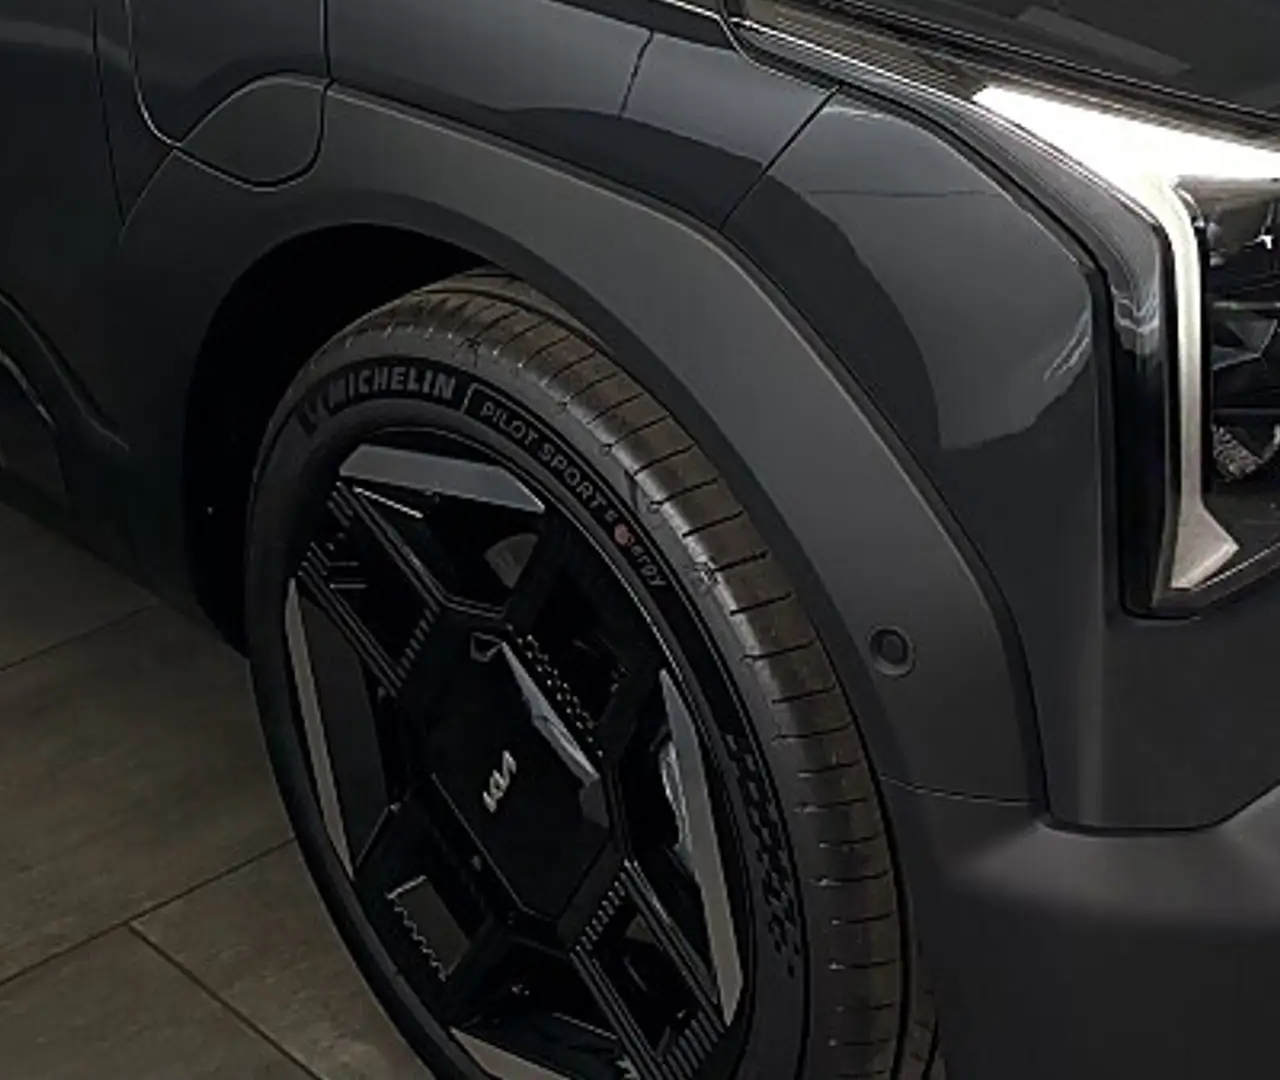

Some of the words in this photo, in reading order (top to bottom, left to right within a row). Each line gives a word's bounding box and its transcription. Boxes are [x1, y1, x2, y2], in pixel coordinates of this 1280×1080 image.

[328, 366, 456, 409] MICHELIN
[480, 401, 539, 446] PILOT
[538, 442, 608, 509] SPORT
